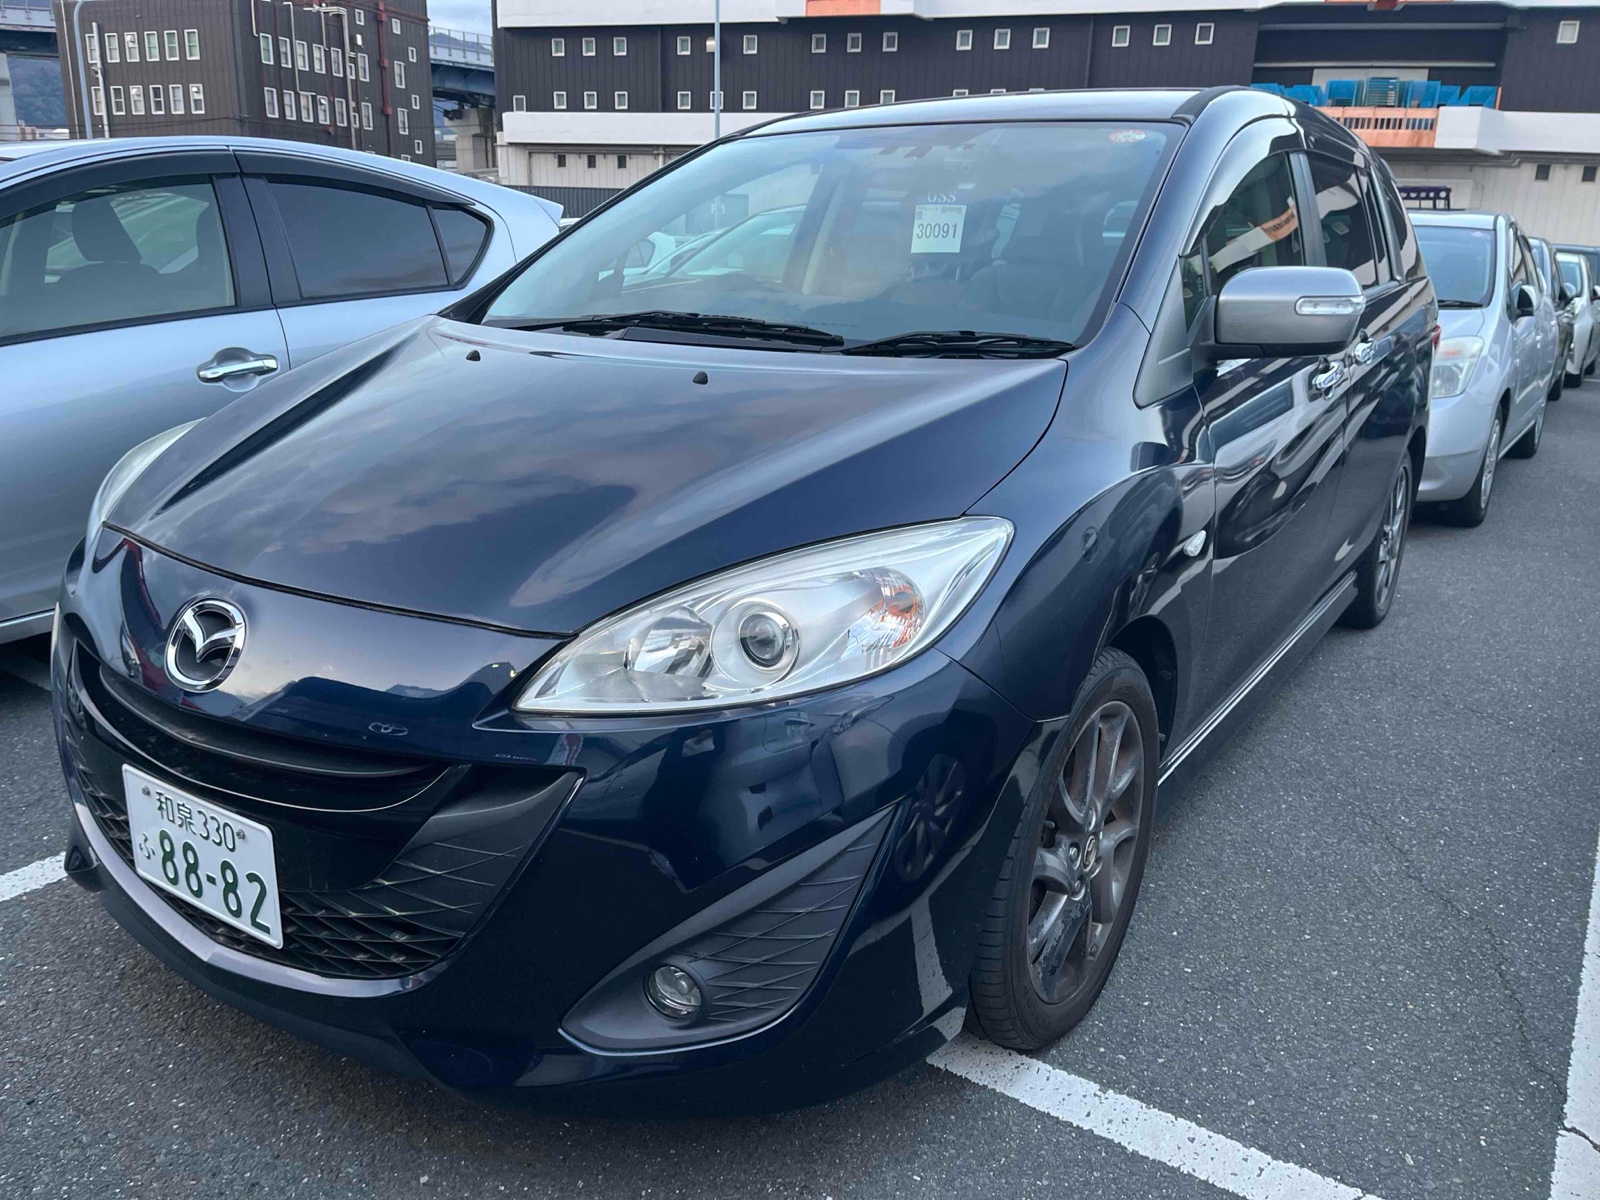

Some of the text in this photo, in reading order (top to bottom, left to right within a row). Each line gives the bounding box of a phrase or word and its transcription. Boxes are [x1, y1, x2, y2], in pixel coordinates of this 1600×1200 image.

[916, 223, 958, 239] 30091
[139, 829, 271, 935] ふ 88-82
